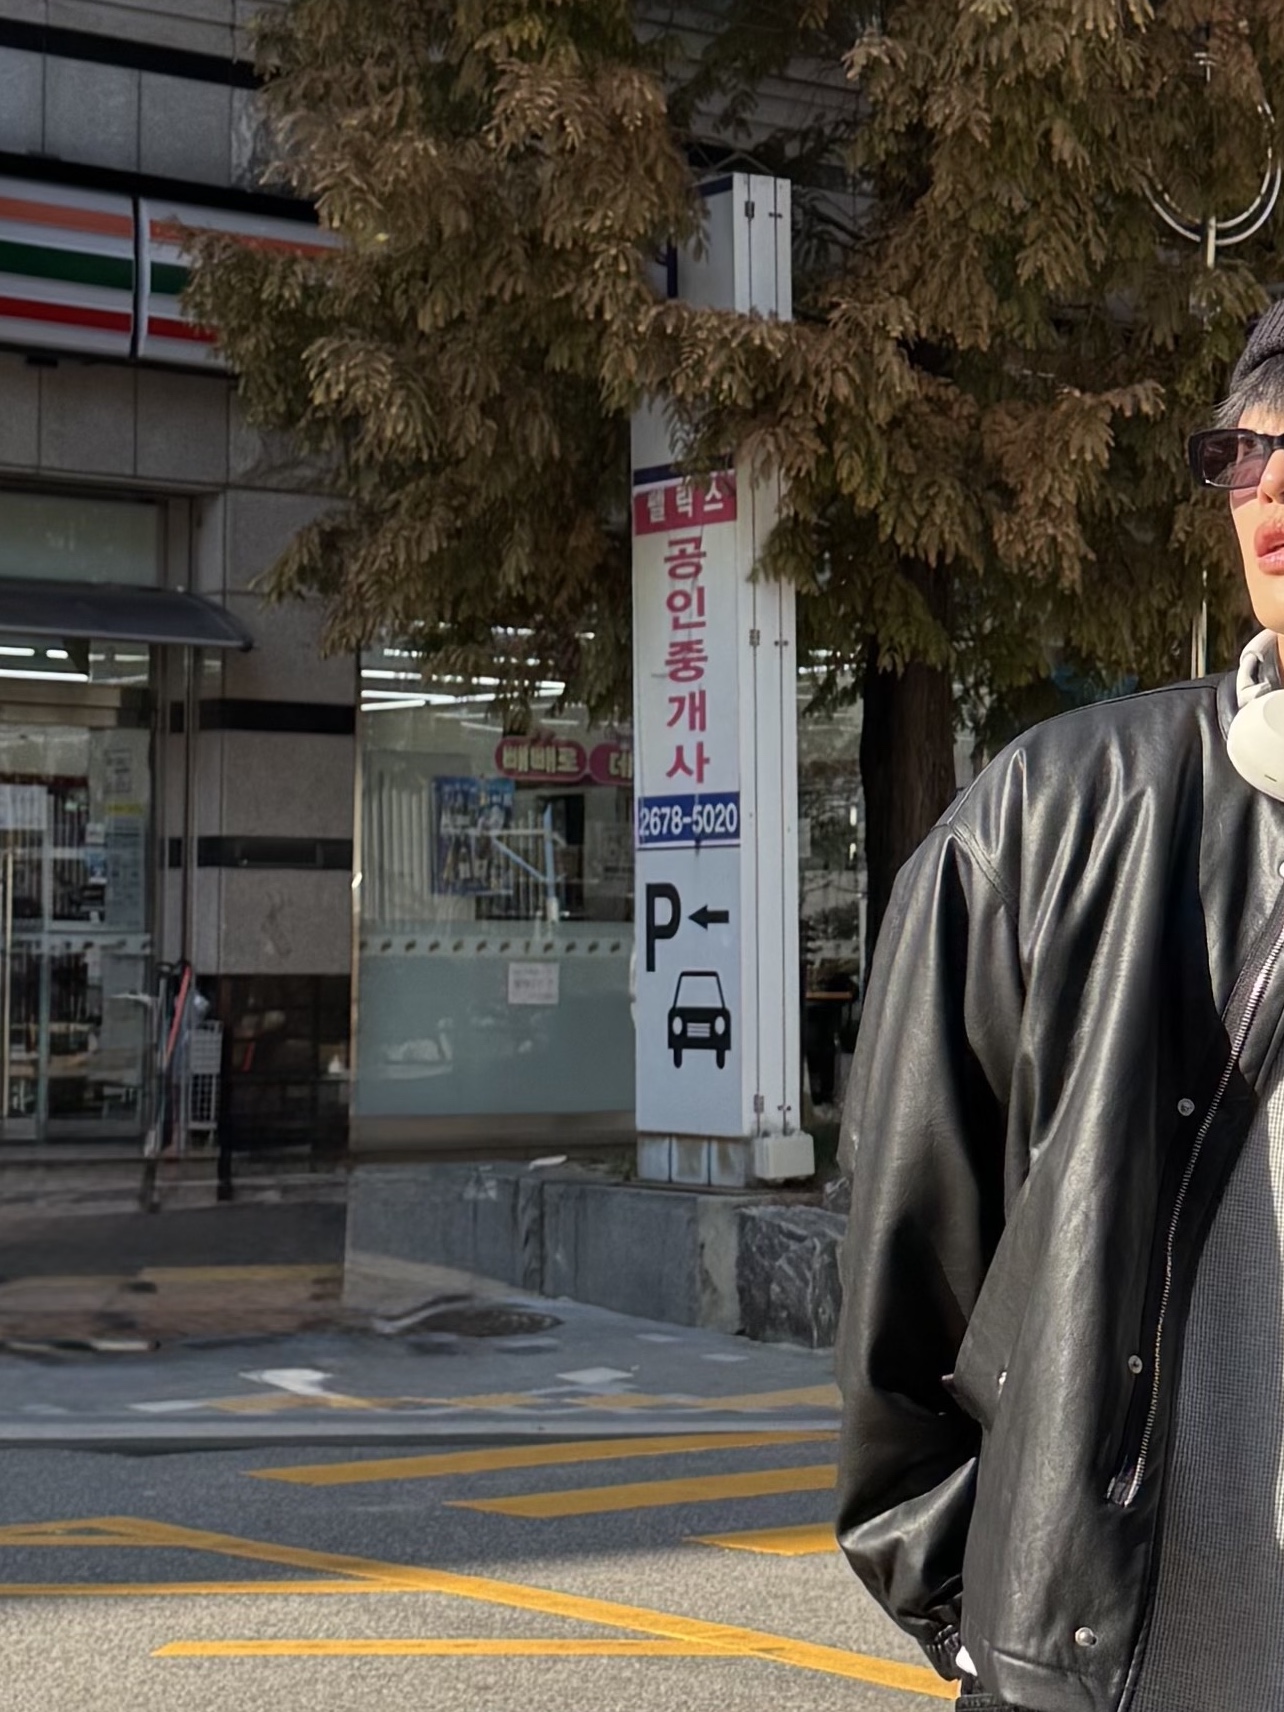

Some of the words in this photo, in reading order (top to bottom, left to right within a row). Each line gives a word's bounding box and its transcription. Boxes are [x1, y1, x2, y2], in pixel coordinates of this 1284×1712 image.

[664, 536, 710, 784] 공인중개사
[502, 745, 580, 774] 빼빼로
[639, 802, 738, 836] 2678-5020
[645, 882, 682, 972] P
